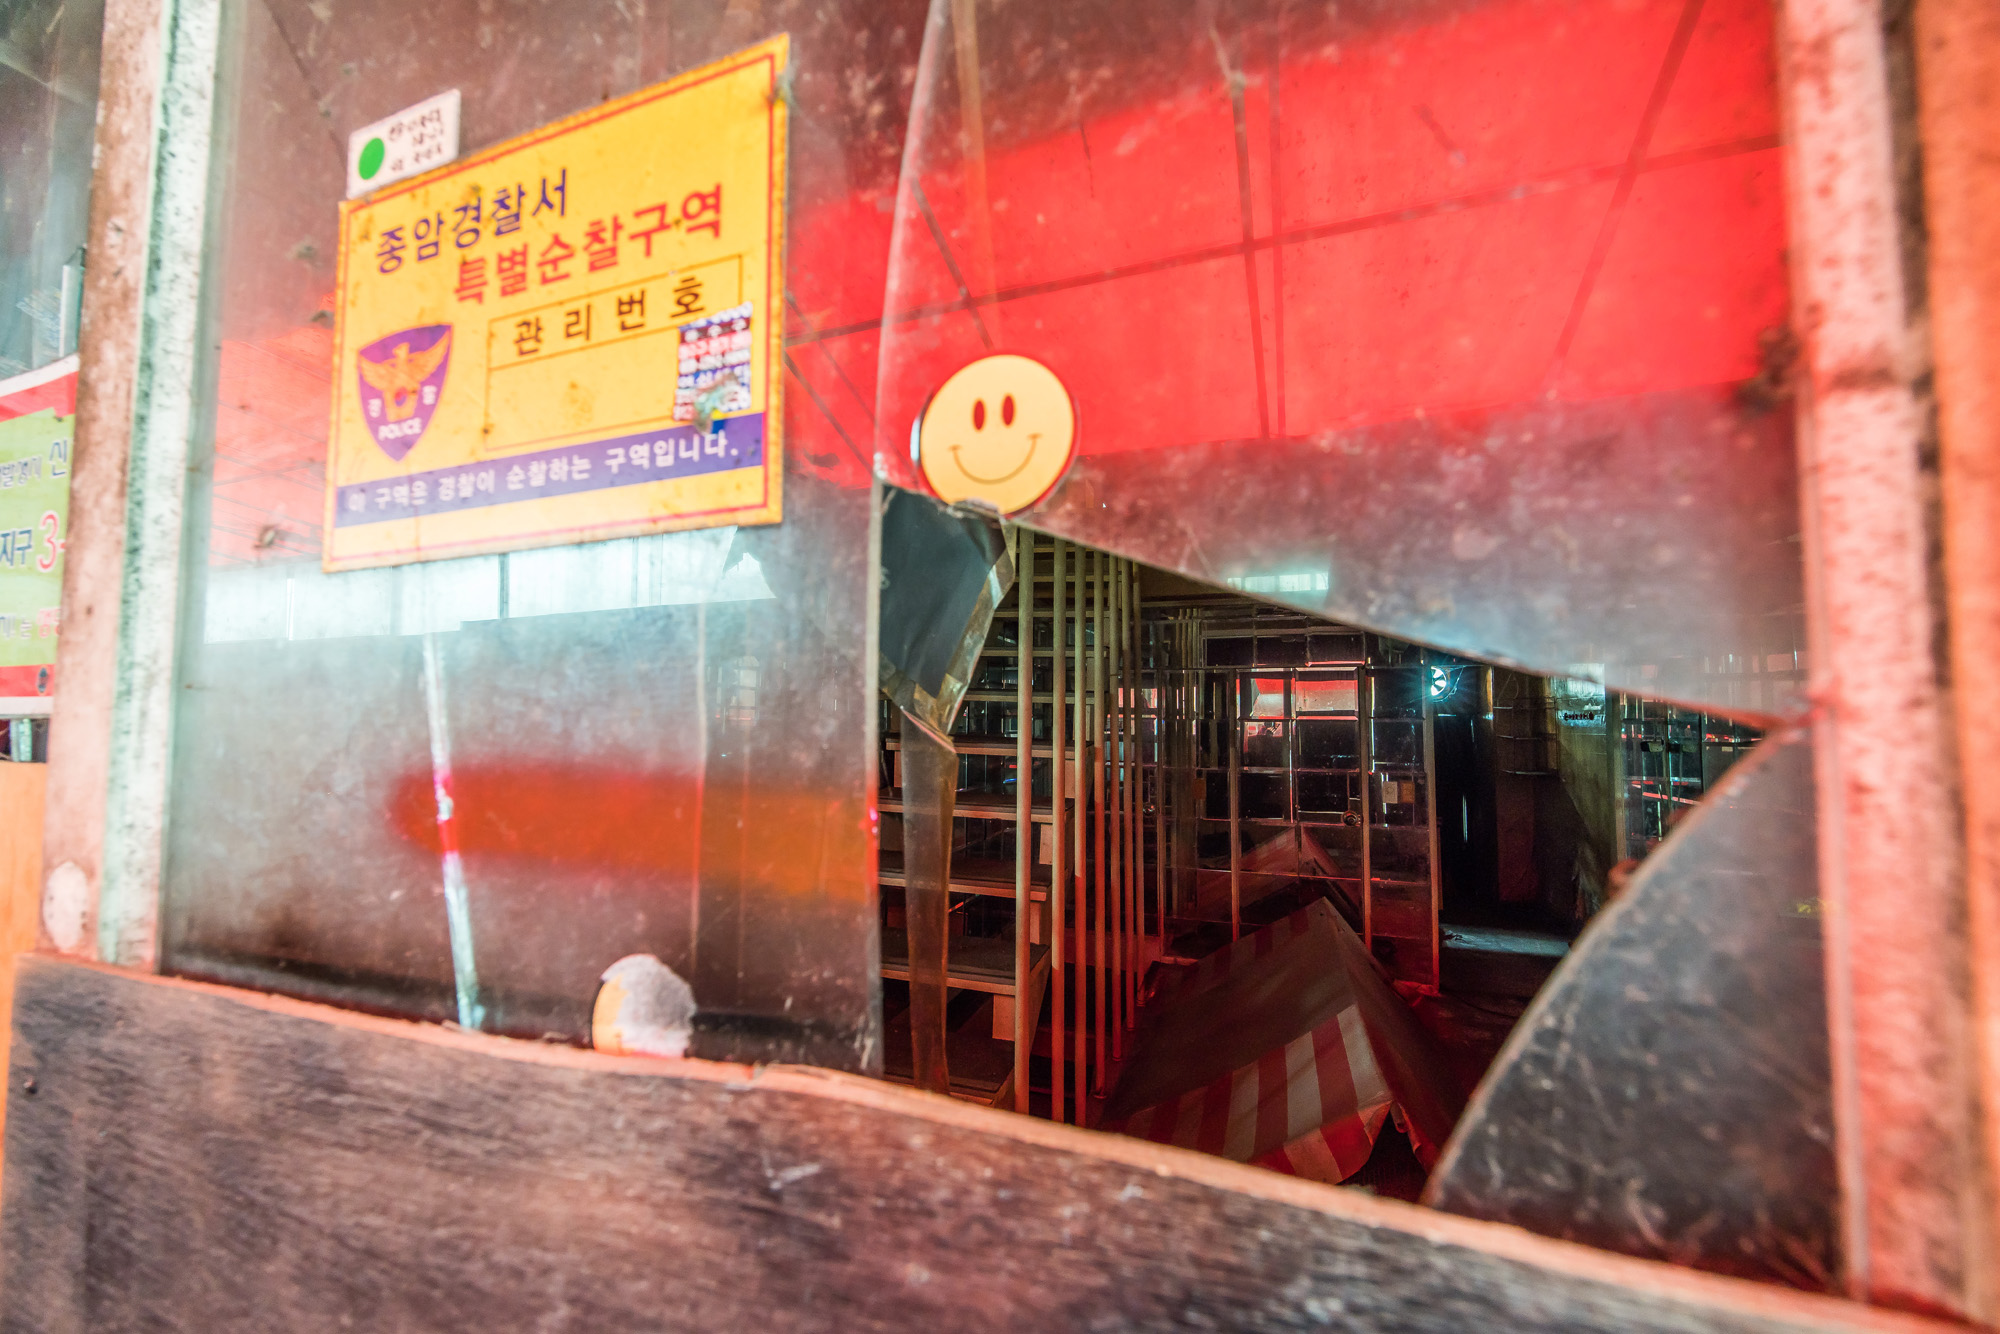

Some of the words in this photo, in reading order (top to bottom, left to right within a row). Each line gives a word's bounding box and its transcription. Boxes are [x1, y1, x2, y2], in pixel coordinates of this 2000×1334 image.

[377, 169, 566, 273] 종암경찰서
[454, 183, 721, 304] 특별순찰구역
[506, 455, 592, 491] 순찰하는
[604, 429, 739, 474] 구역입니다.
